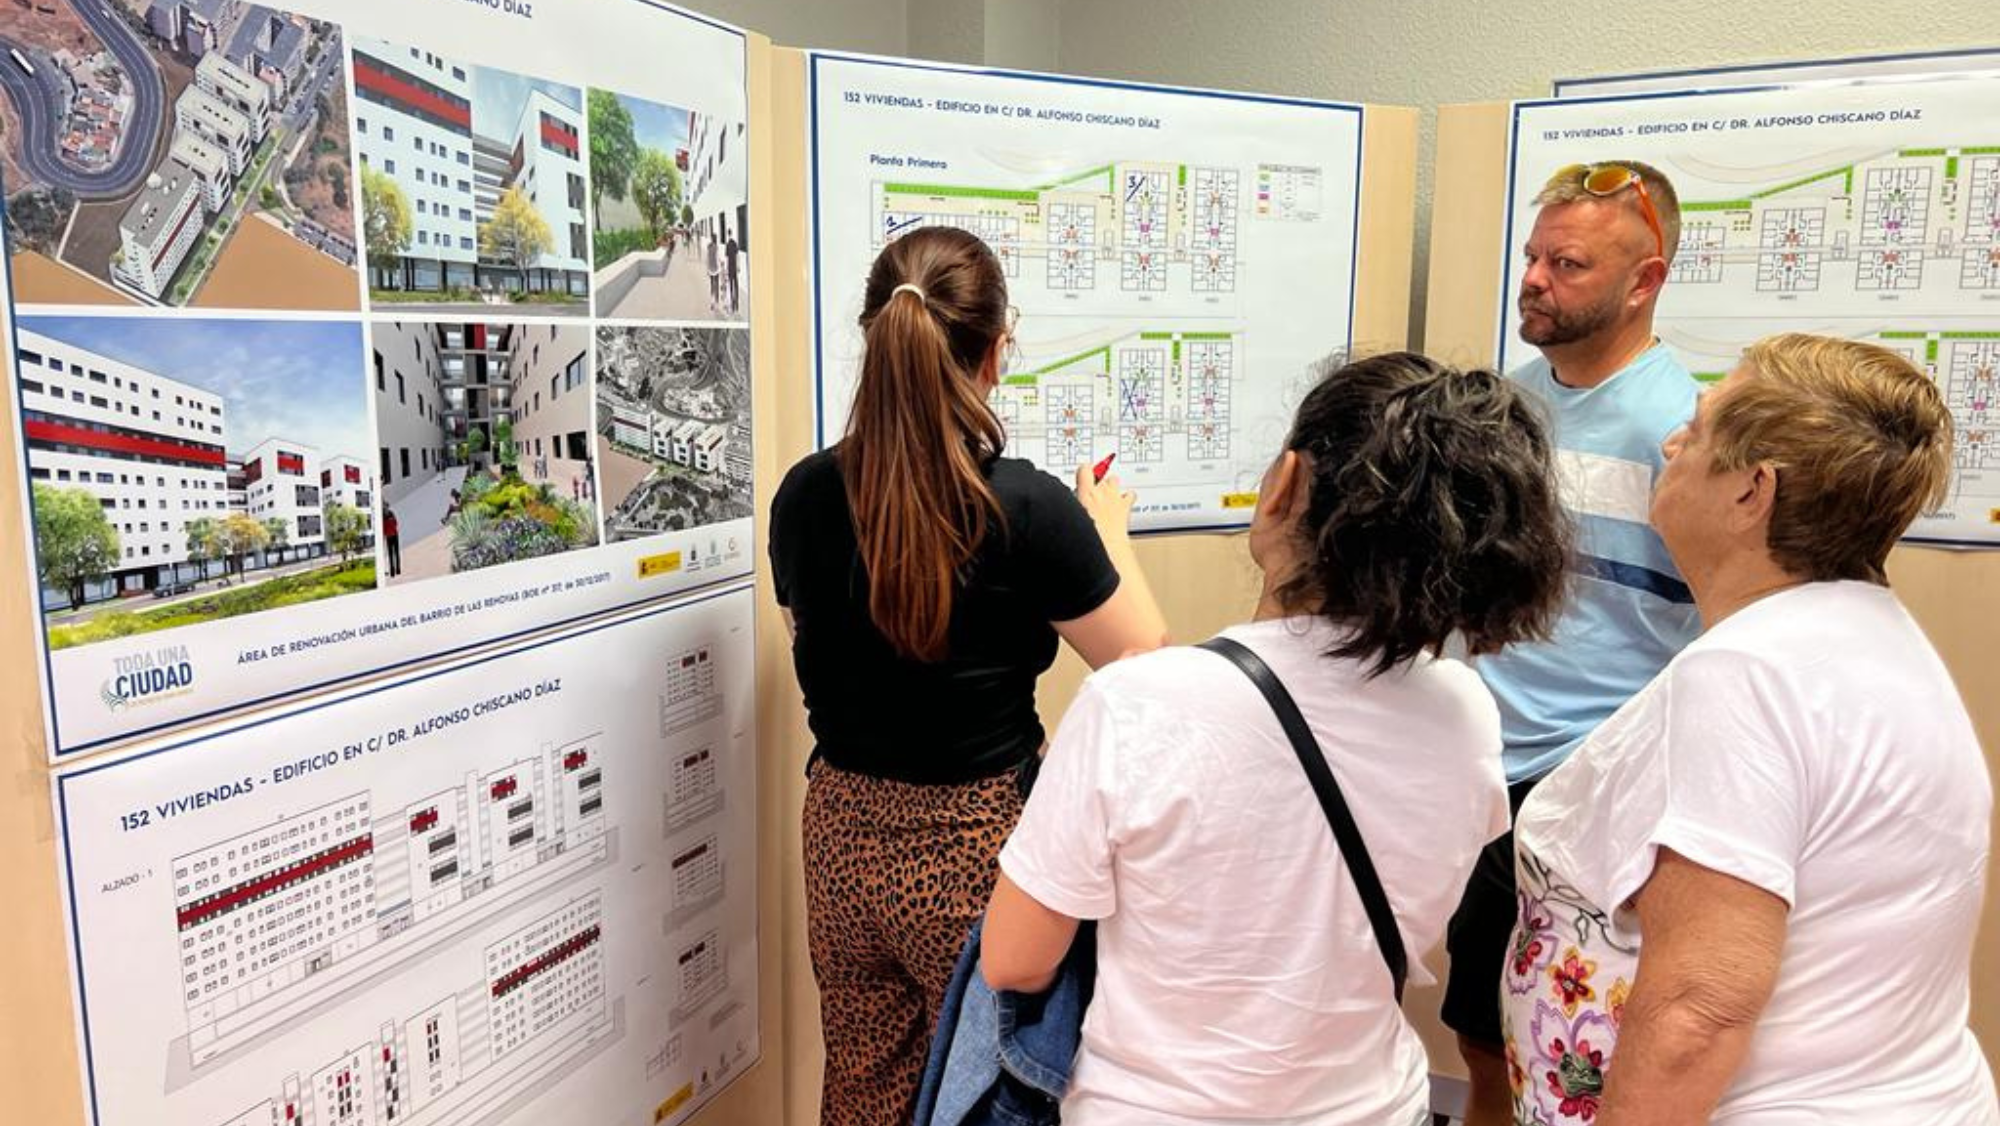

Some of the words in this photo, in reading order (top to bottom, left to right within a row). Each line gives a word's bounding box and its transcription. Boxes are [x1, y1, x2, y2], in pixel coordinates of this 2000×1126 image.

[843, 91, 860, 104] 152
[864, 93, 923, 109] VIVIENDAS
[936, 99, 981, 114] EDIFICIO
[984, 104, 998, 114] EN
[1001, 105, 1014, 117] C/
[1017, 107, 1032, 118] DR.
[1037, 109, 1083, 122] ALFONSO
[1086, 113, 1135, 127] CHISCANO
[1138, 115, 1161, 129] DÍAZ
[1543, 130, 1559, 140] 152
[1563, 127, 1624, 139] VIVIENDAS
[1638, 123, 1688, 135] EDIFICIO
[1692, 121, 1708, 131] EN
[1712, 119, 1725, 131] C/
[1730, 118, 1750, 129] DR.
[1754, 115, 1813, 128] ALFONSO
[1818, 111, 1885, 124] CHISCANO
[1890, 107, 1921, 120] DÍAZ
[870, 154, 903, 167] Planta
[908, 157, 947, 169] Primera
[237, 650, 268, 664] ÁREA
[271, 644, 286, 657] DE
[289, 627, 357, 653] RENOVACIÓN
[359, 620, 398, 637] URBANA
[400, 615, 417, 628] DEL
[420, 606, 451, 623] BARRIO
[454, 604, 465, 615] DE
[468, 601, 482, 613] LAS
[113, 651, 154, 675] TODA
[158, 644, 190, 665] UNA
[115, 662, 192, 699] CIUDAD
[120, 809, 151, 832] 152
[156, 776, 254, 820] VIVIENDAS
[273, 751, 338, 784] EDIFICIO
[343, 742, 363, 761] EN
[367, 735, 384, 753] C/
[387, 728, 409, 746] DR.
[412, 708, 470, 738] ALFONSO
[473, 688, 532, 717] CHISCANO
[534, 679, 562, 697] DÍAZ
[101, 872, 140, 894] ALZADO
